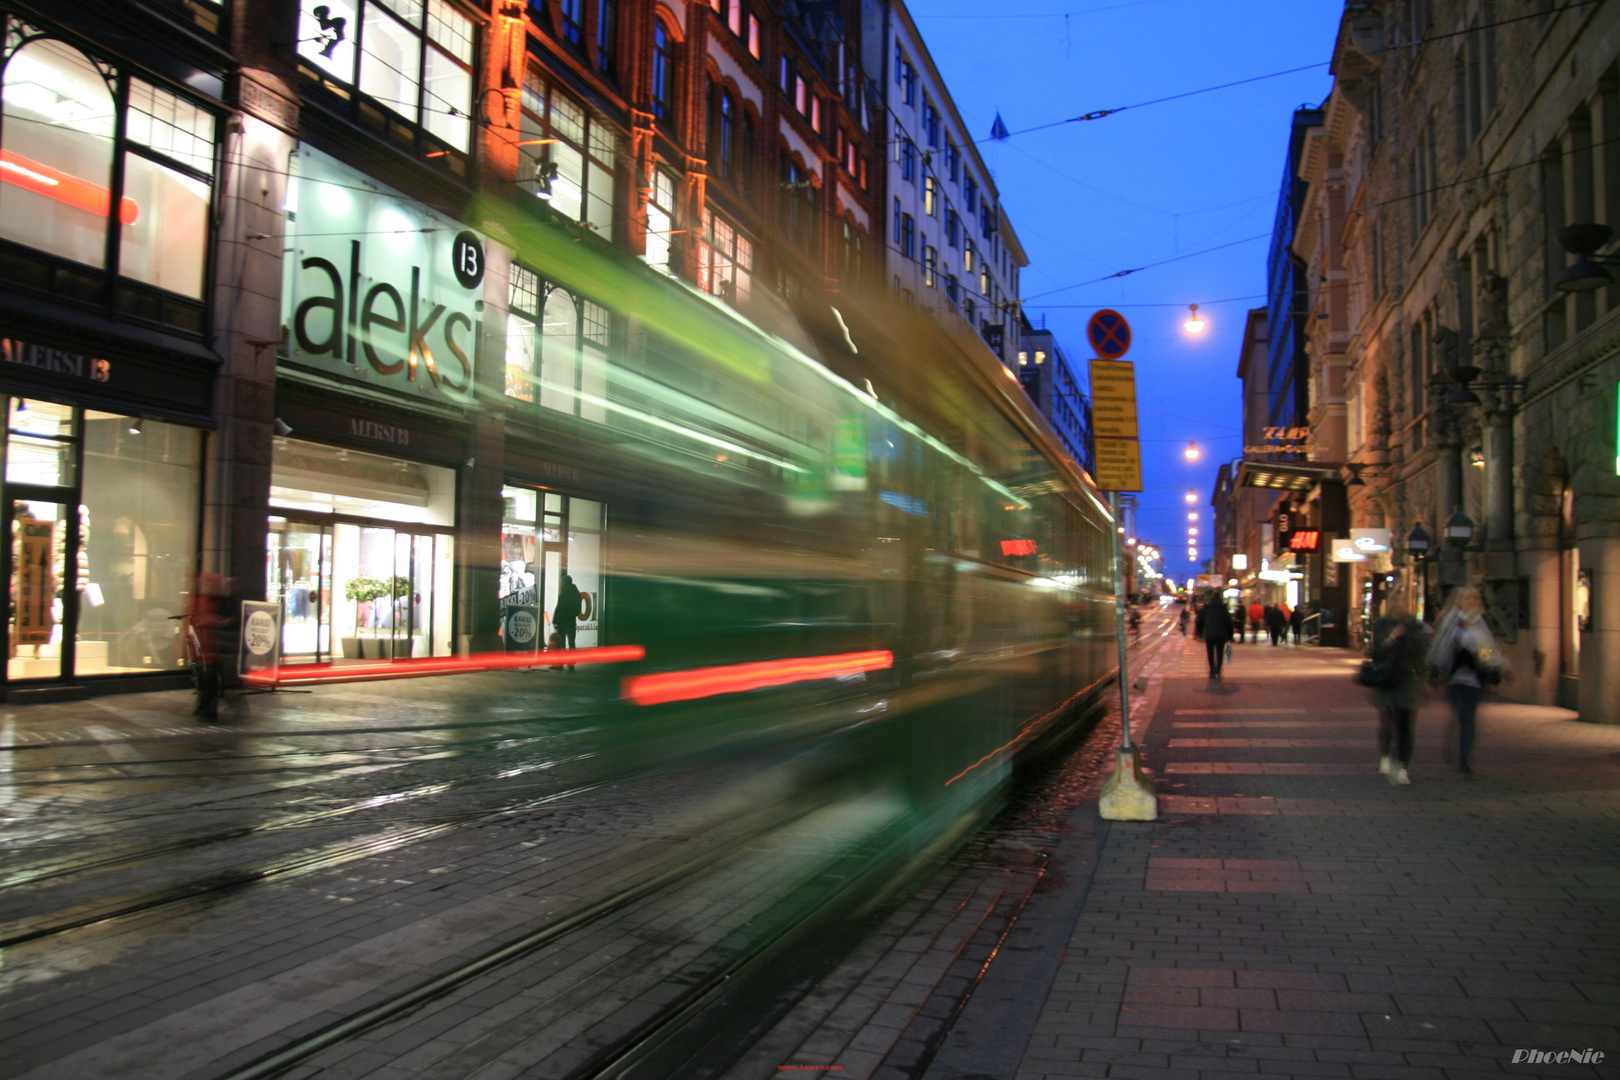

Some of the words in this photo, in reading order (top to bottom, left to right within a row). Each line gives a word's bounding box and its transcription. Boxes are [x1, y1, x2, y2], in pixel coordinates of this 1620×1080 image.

[460, 242, 478, 277] 13
[294, 239, 484, 399] aleksi
[89, 358, 110, 382] 13
[348, 418, 395, 443] ALEKSI
[397, 428, 409, 446] 13
[247, 633, 270, 648] -20%
[511, 627, 532, 638] -20%
